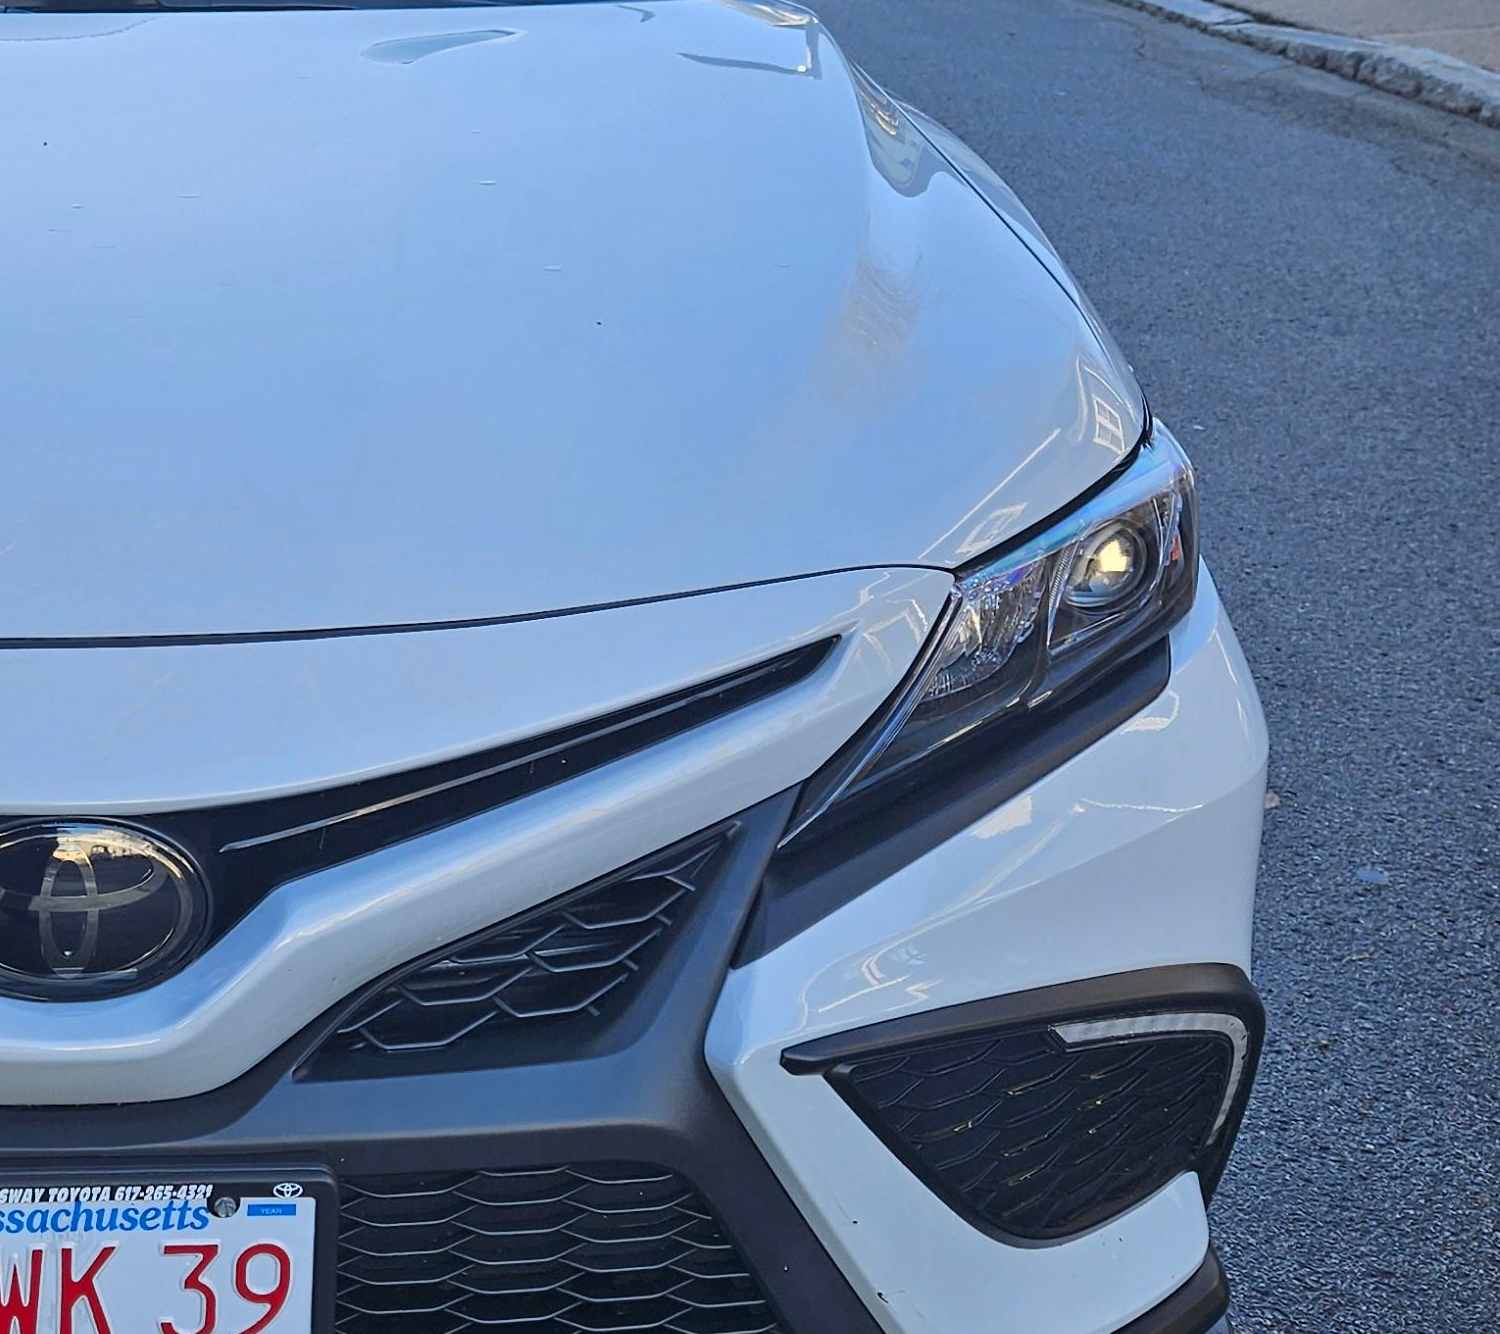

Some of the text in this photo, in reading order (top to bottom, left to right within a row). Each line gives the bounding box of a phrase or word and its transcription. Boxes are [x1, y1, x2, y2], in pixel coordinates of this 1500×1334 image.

[47, 1185, 112, 1204] TOYOTA
[114, 1183, 214, 1201] 617-265-4321
[260, 1207, 283, 1215] YEAR
